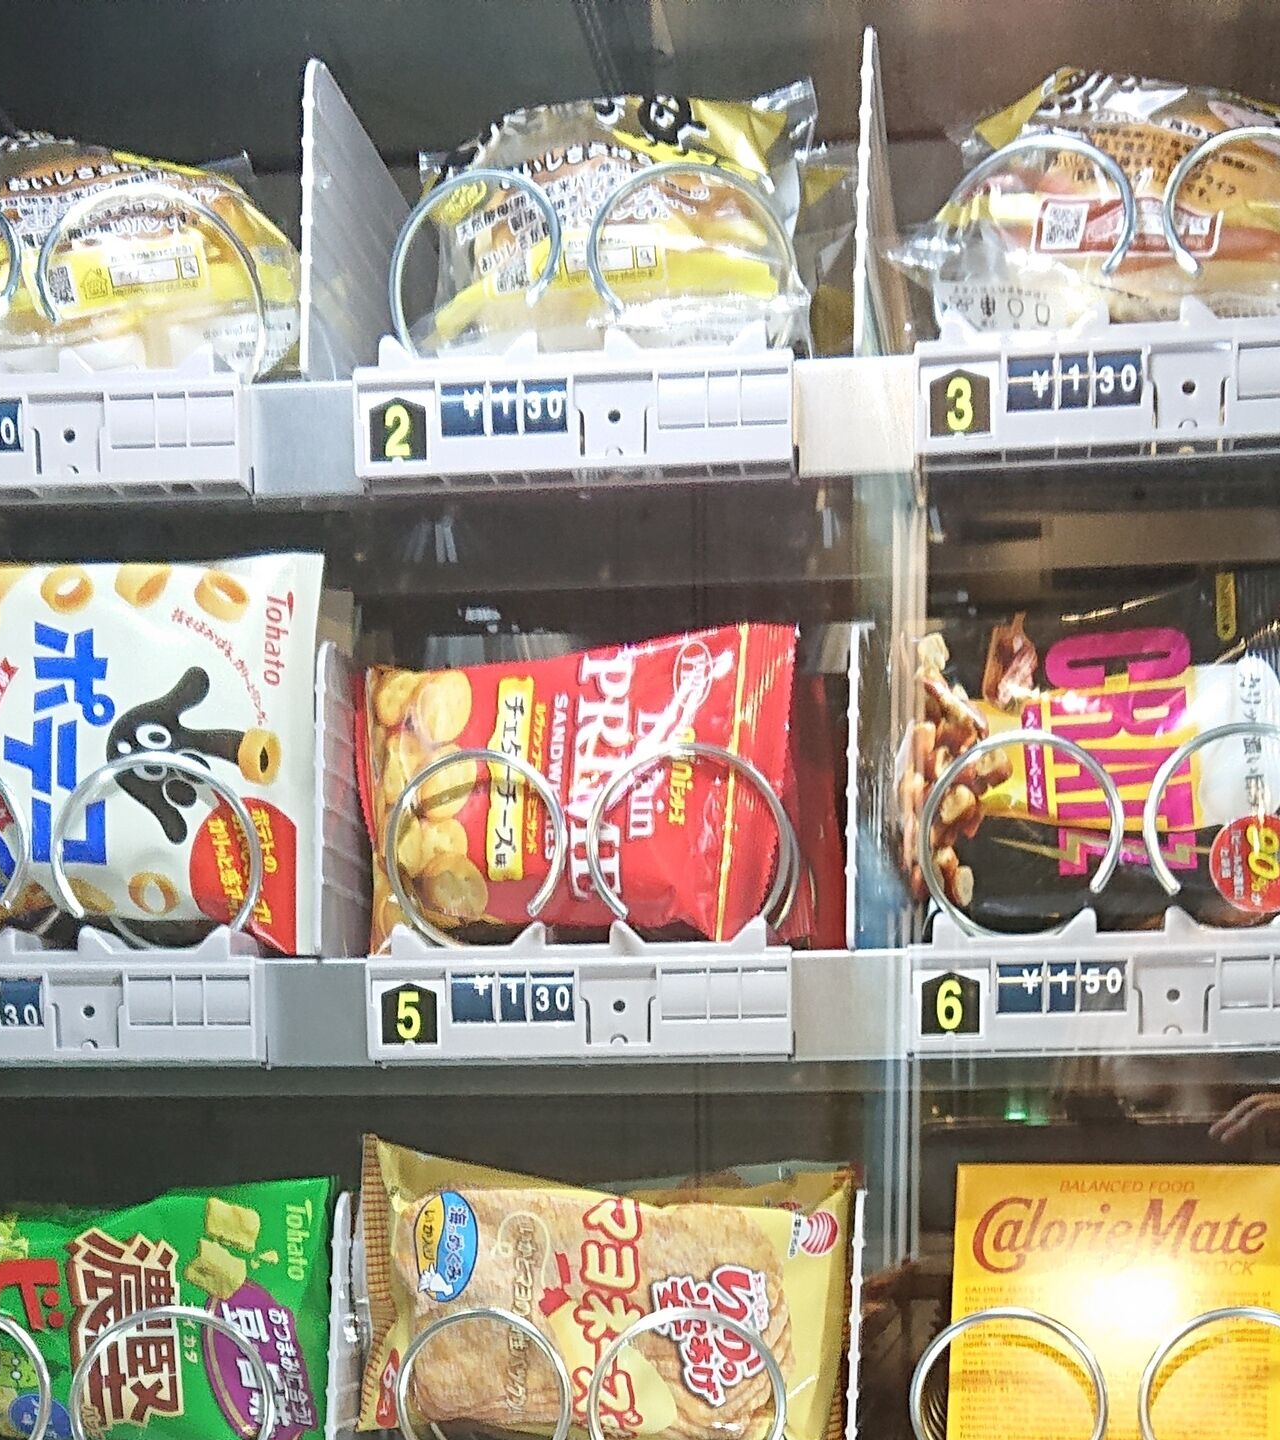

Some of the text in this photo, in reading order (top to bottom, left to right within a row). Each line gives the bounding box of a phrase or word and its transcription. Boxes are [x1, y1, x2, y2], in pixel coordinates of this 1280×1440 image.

[383, 403, 411, 457] 2
[946, 377, 974, 430] 3
[261, 590, 296, 687] Tohato
[2, 620, 116, 866] ポテコ
[1045, 627, 1199, 877] CRATZ
[397, 990, 422, 1040] 5
[936, 979, 963, 1030] 6
[1060, 1180, 1195, 1194] BALANCED FOOD
[285, 1198, 313, 1282] Tohato
